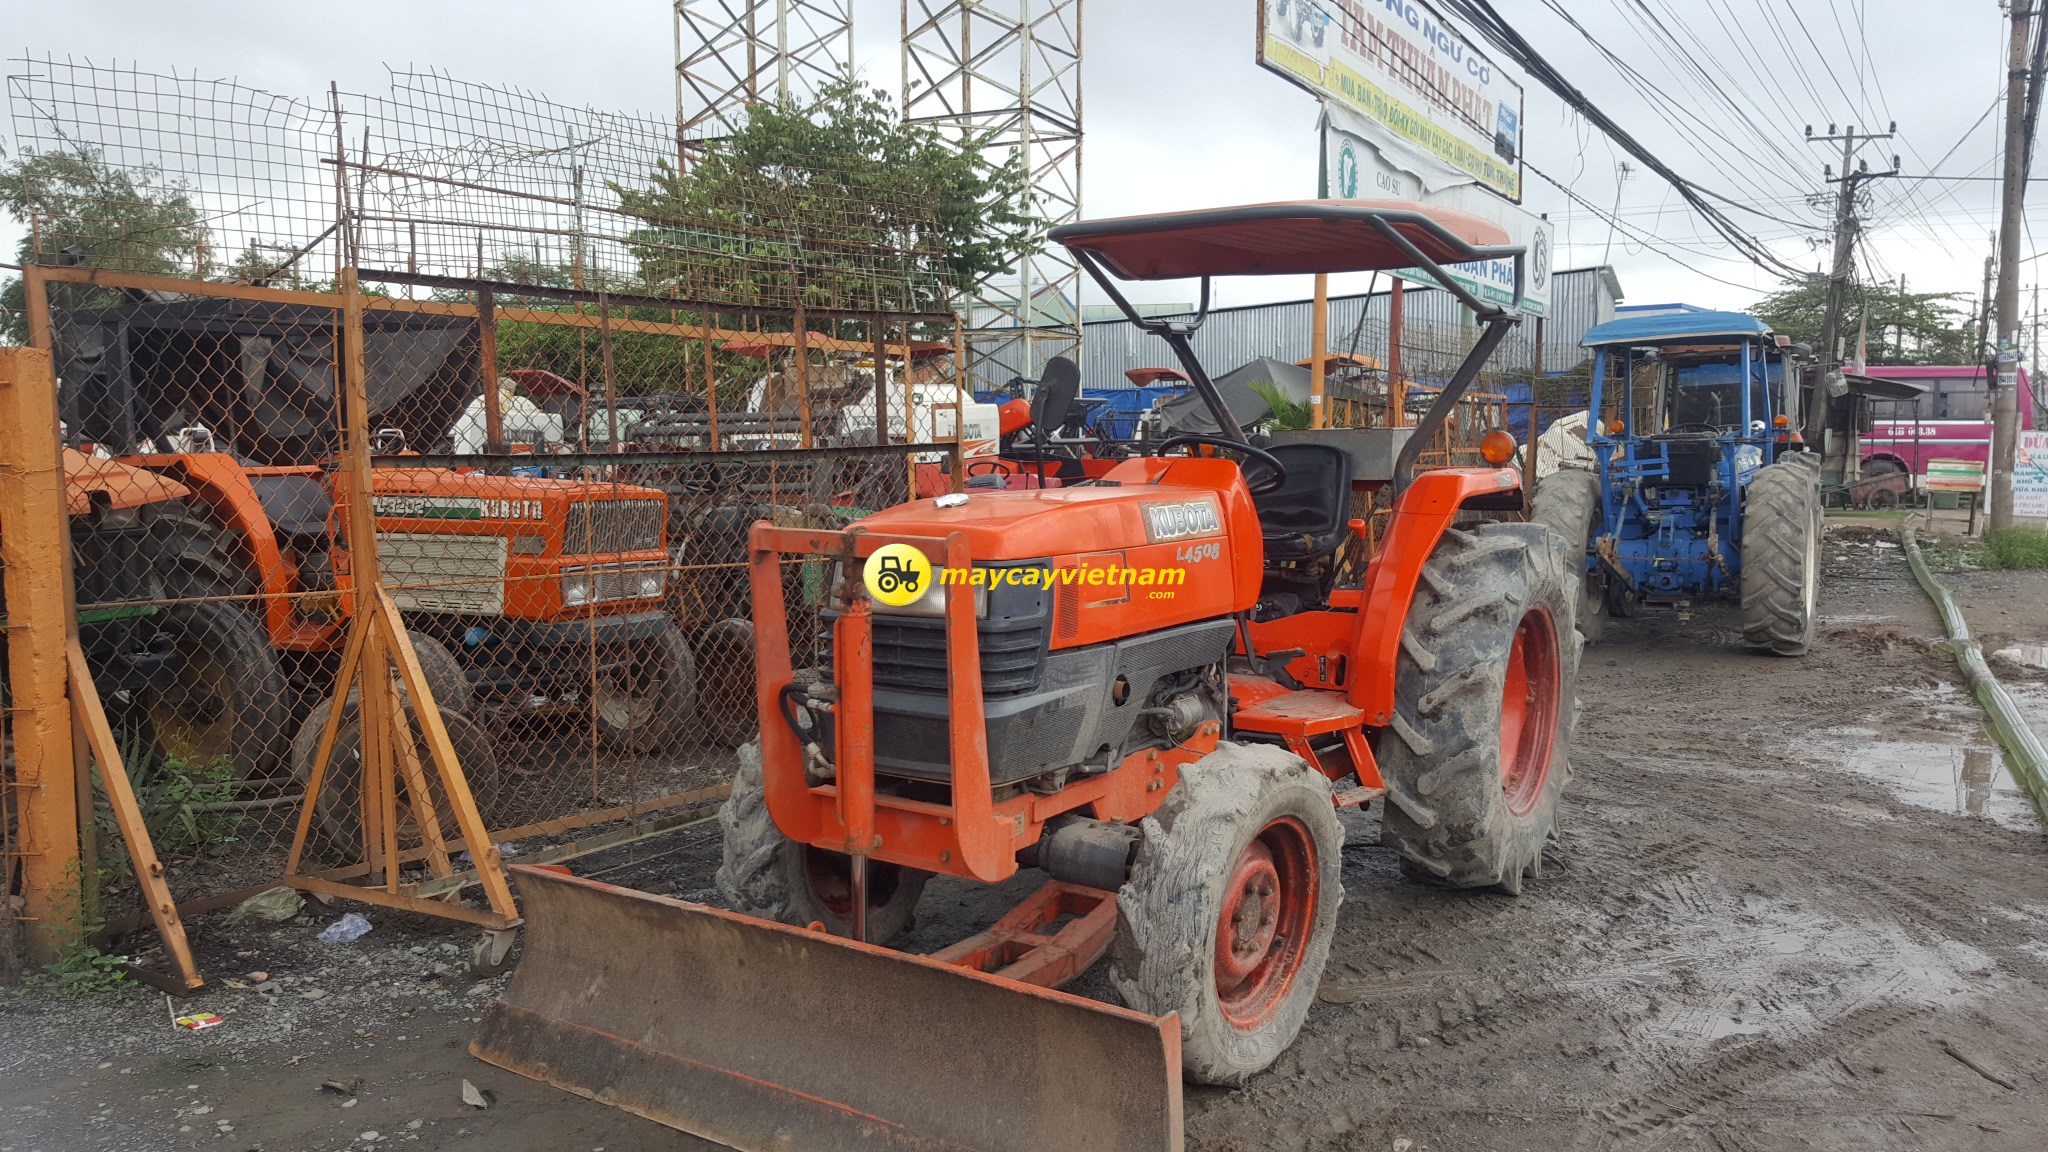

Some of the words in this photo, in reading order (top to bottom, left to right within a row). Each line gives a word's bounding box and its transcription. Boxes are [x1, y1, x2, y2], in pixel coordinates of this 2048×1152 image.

[1340, 73, 1355, 99] MUA
[1376, 171, 1391, 192] CAO
[1391, 178, 1401, 196] SU
[1491, 258, 1514, 288] PHÁ
[481, 499, 543, 519] KUBOTA
[1149, 502, 1219, 538] KUBOTA
[1176, 542, 1221, 563] L4508
